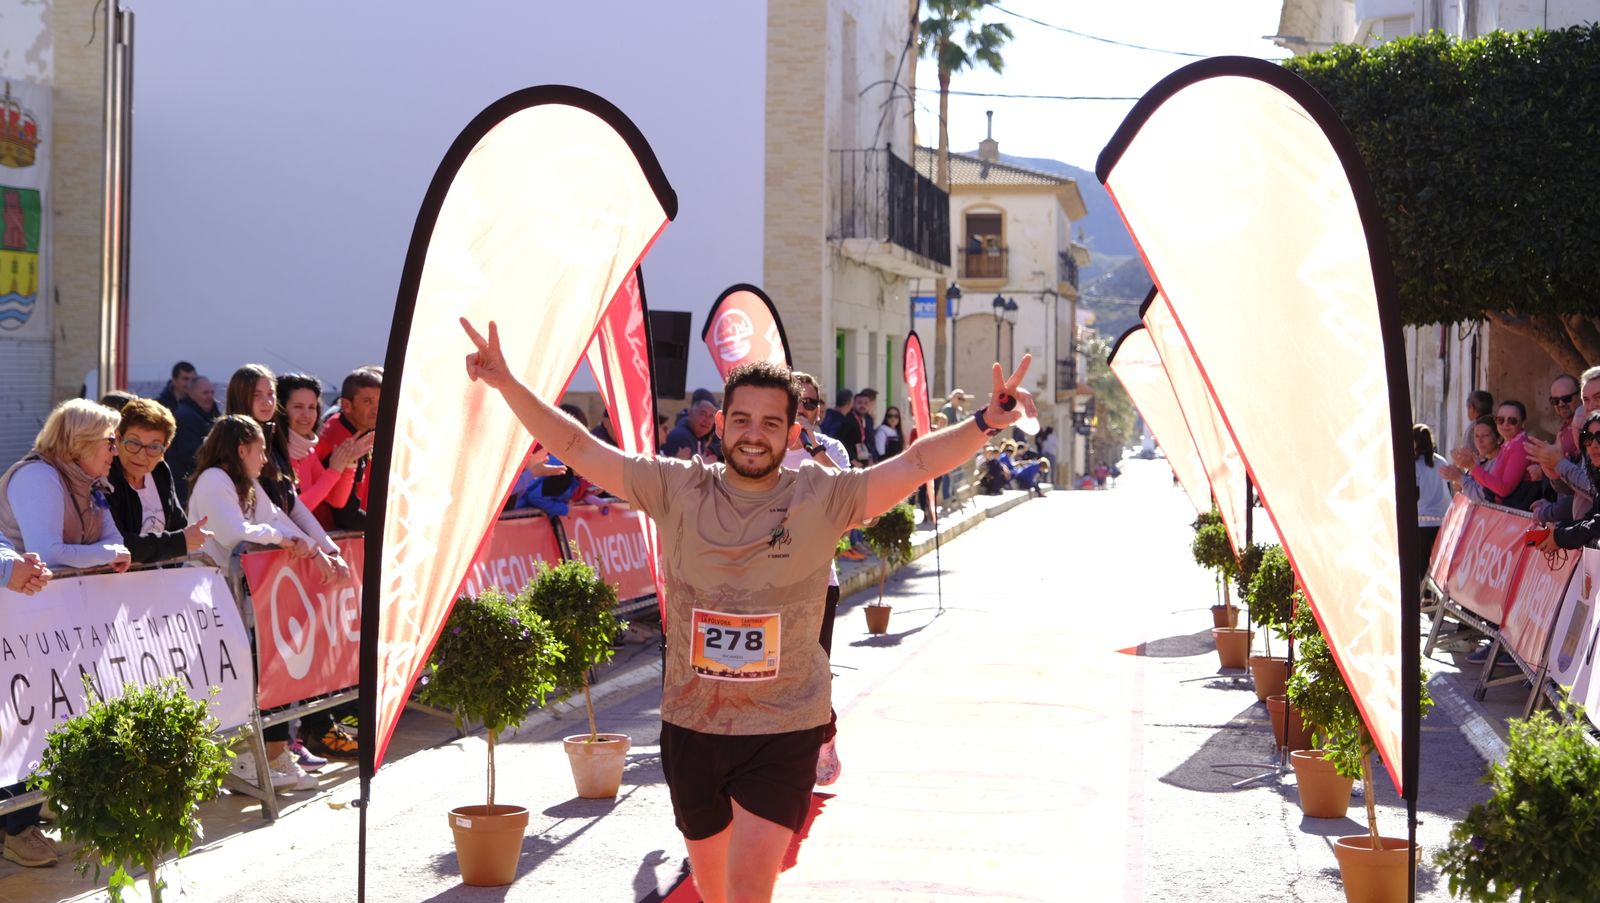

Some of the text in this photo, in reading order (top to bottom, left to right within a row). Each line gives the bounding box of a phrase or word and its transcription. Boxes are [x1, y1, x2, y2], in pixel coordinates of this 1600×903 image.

[480, 553, 543, 602] VEOLI
[595, 532, 648, 575] VEOLIA
[2, 606, 225, 662] AYUNTAMIENTO DE
[706, 628, 763, 651] 278
[10, 638, 239, 726] CANTORIA
